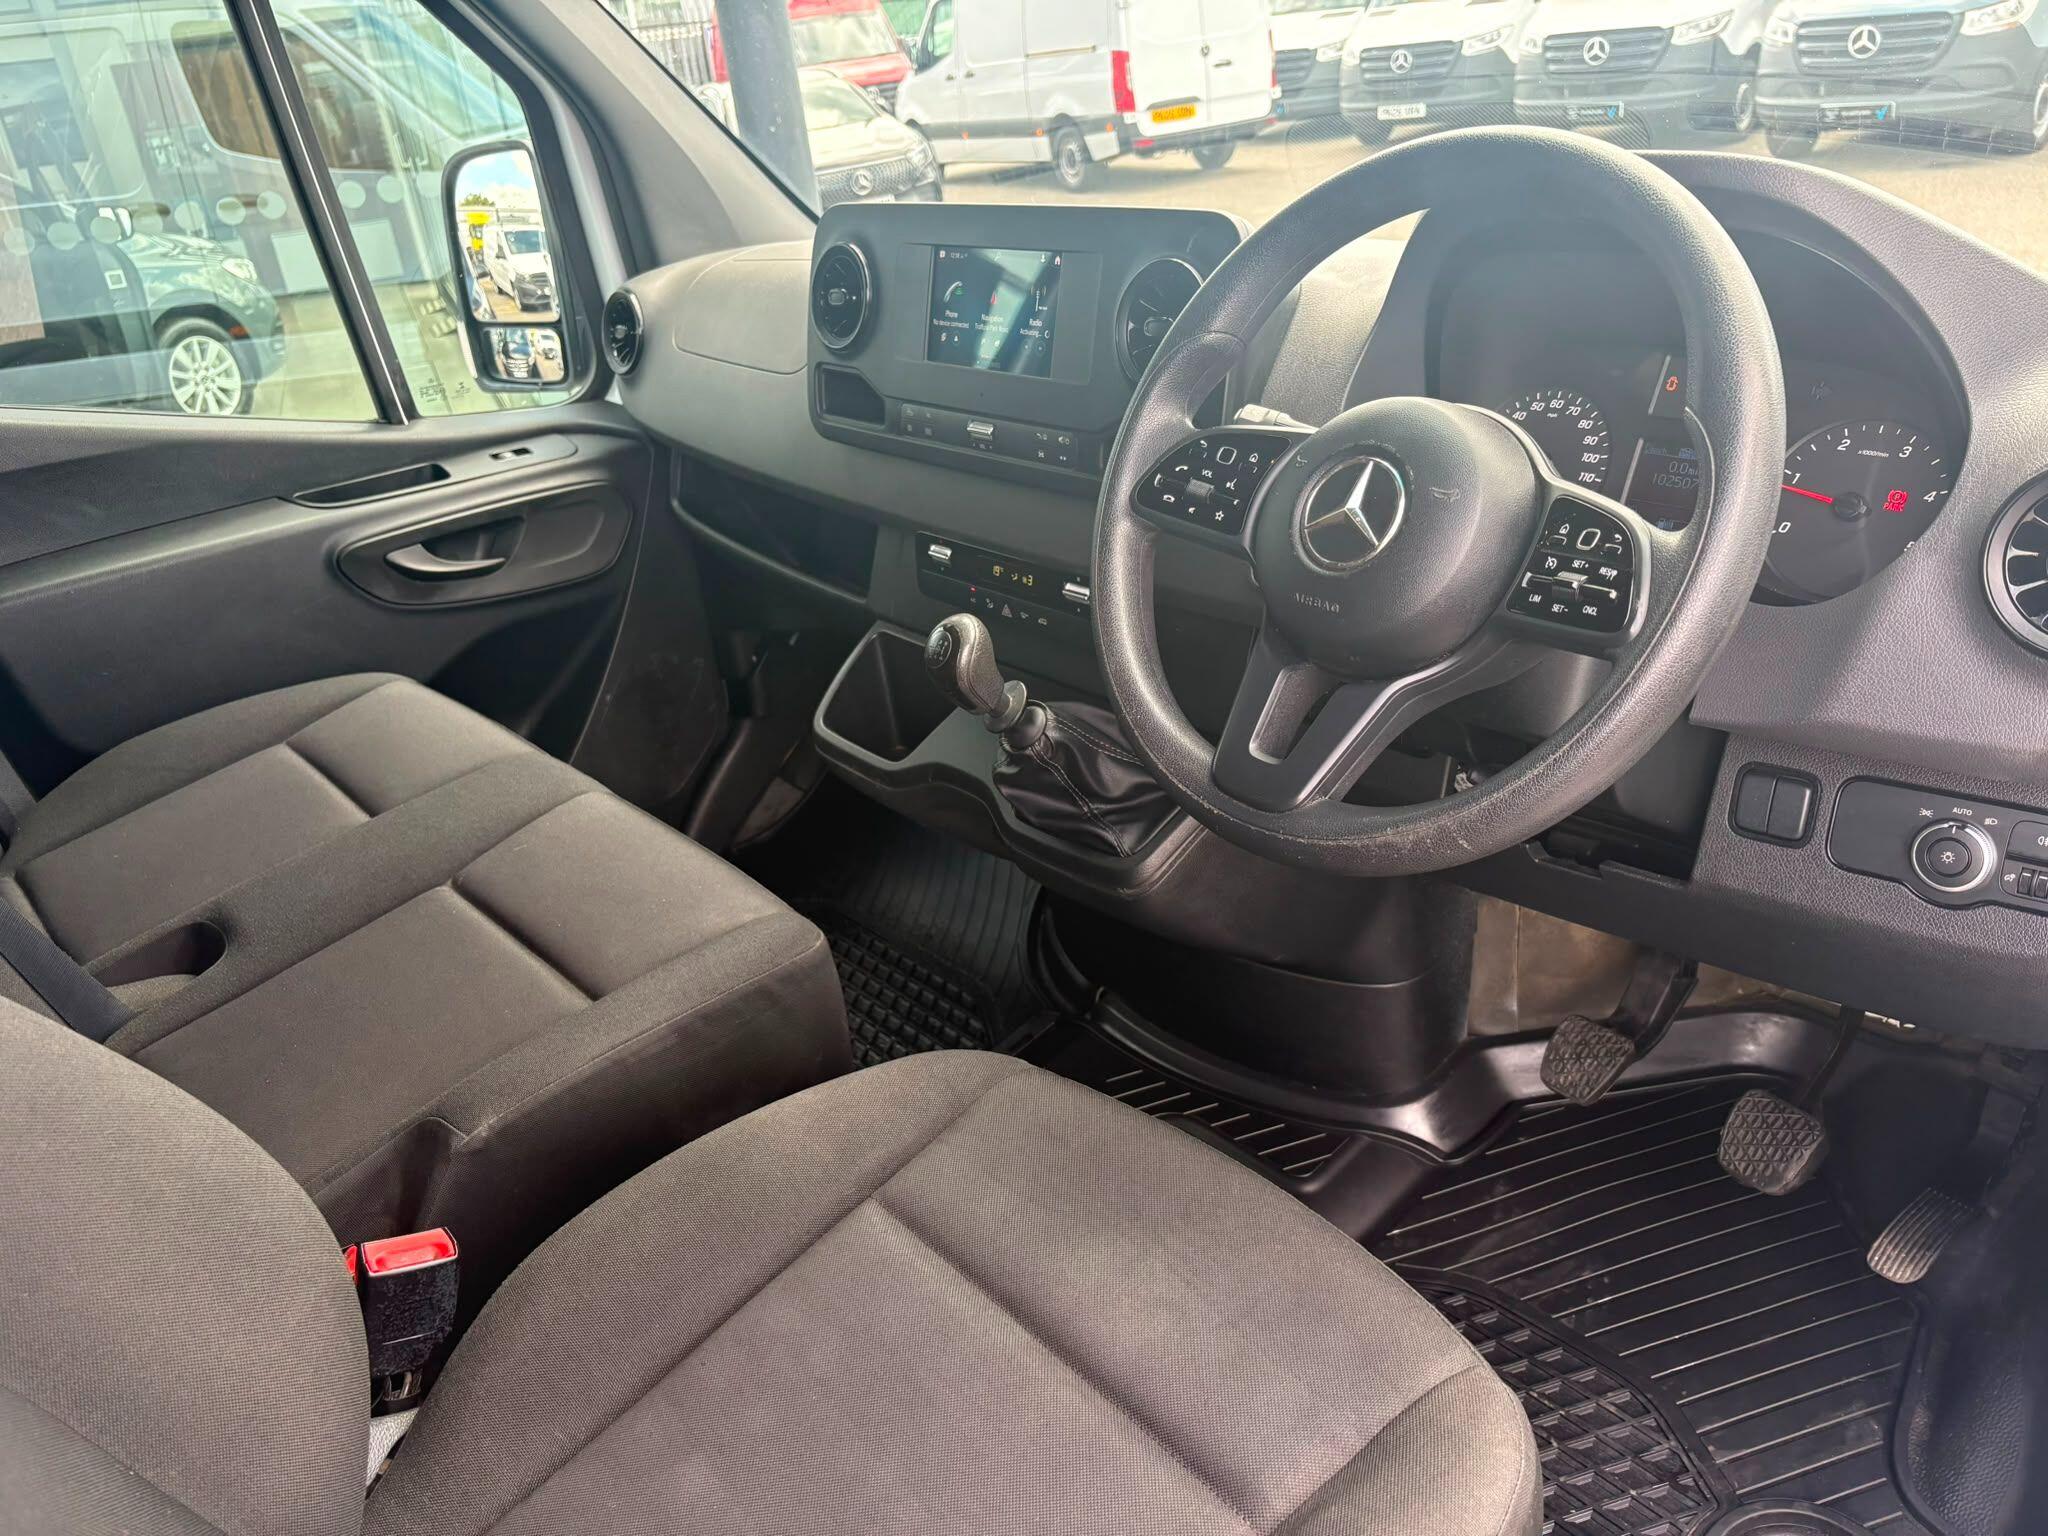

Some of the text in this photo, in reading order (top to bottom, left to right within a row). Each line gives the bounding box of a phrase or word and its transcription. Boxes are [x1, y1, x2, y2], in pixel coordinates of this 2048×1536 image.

[1029, 318, 1043, 327] Radio
[1530, 402, 1545, 411] 50
[1549, 399, 1564, 409] 60
[1512, 411, 1527, 421] 40
[1565, 406, 1581, 416] 70
[1577, 419, 1593, 430] 80
[1582, 435, 1598, 446] 90
[1837, 439, 1850, 451] 2
[1899, 446, 1912, 458] 3
[1581, 452, 1600, 464] 100
[1201, 468, 1213, 479] VOL
[1578, 472, 1596, 483] 110
[1792, 473, 1801, 484] 1
[1651, 473, 1699, 489] 102507
[1923, 491, 1937, 502] 4
[1883, 502, 1905, 512] PARK
[1778, 521, 1791, 533] 0
[1290, 592, 1341, 613] AIRBAG
[1528, 593, 1542, 604] LIM
[1582, 604, 1598, 616] CNCL
[1952, 807, 1973, 816] AUTO
